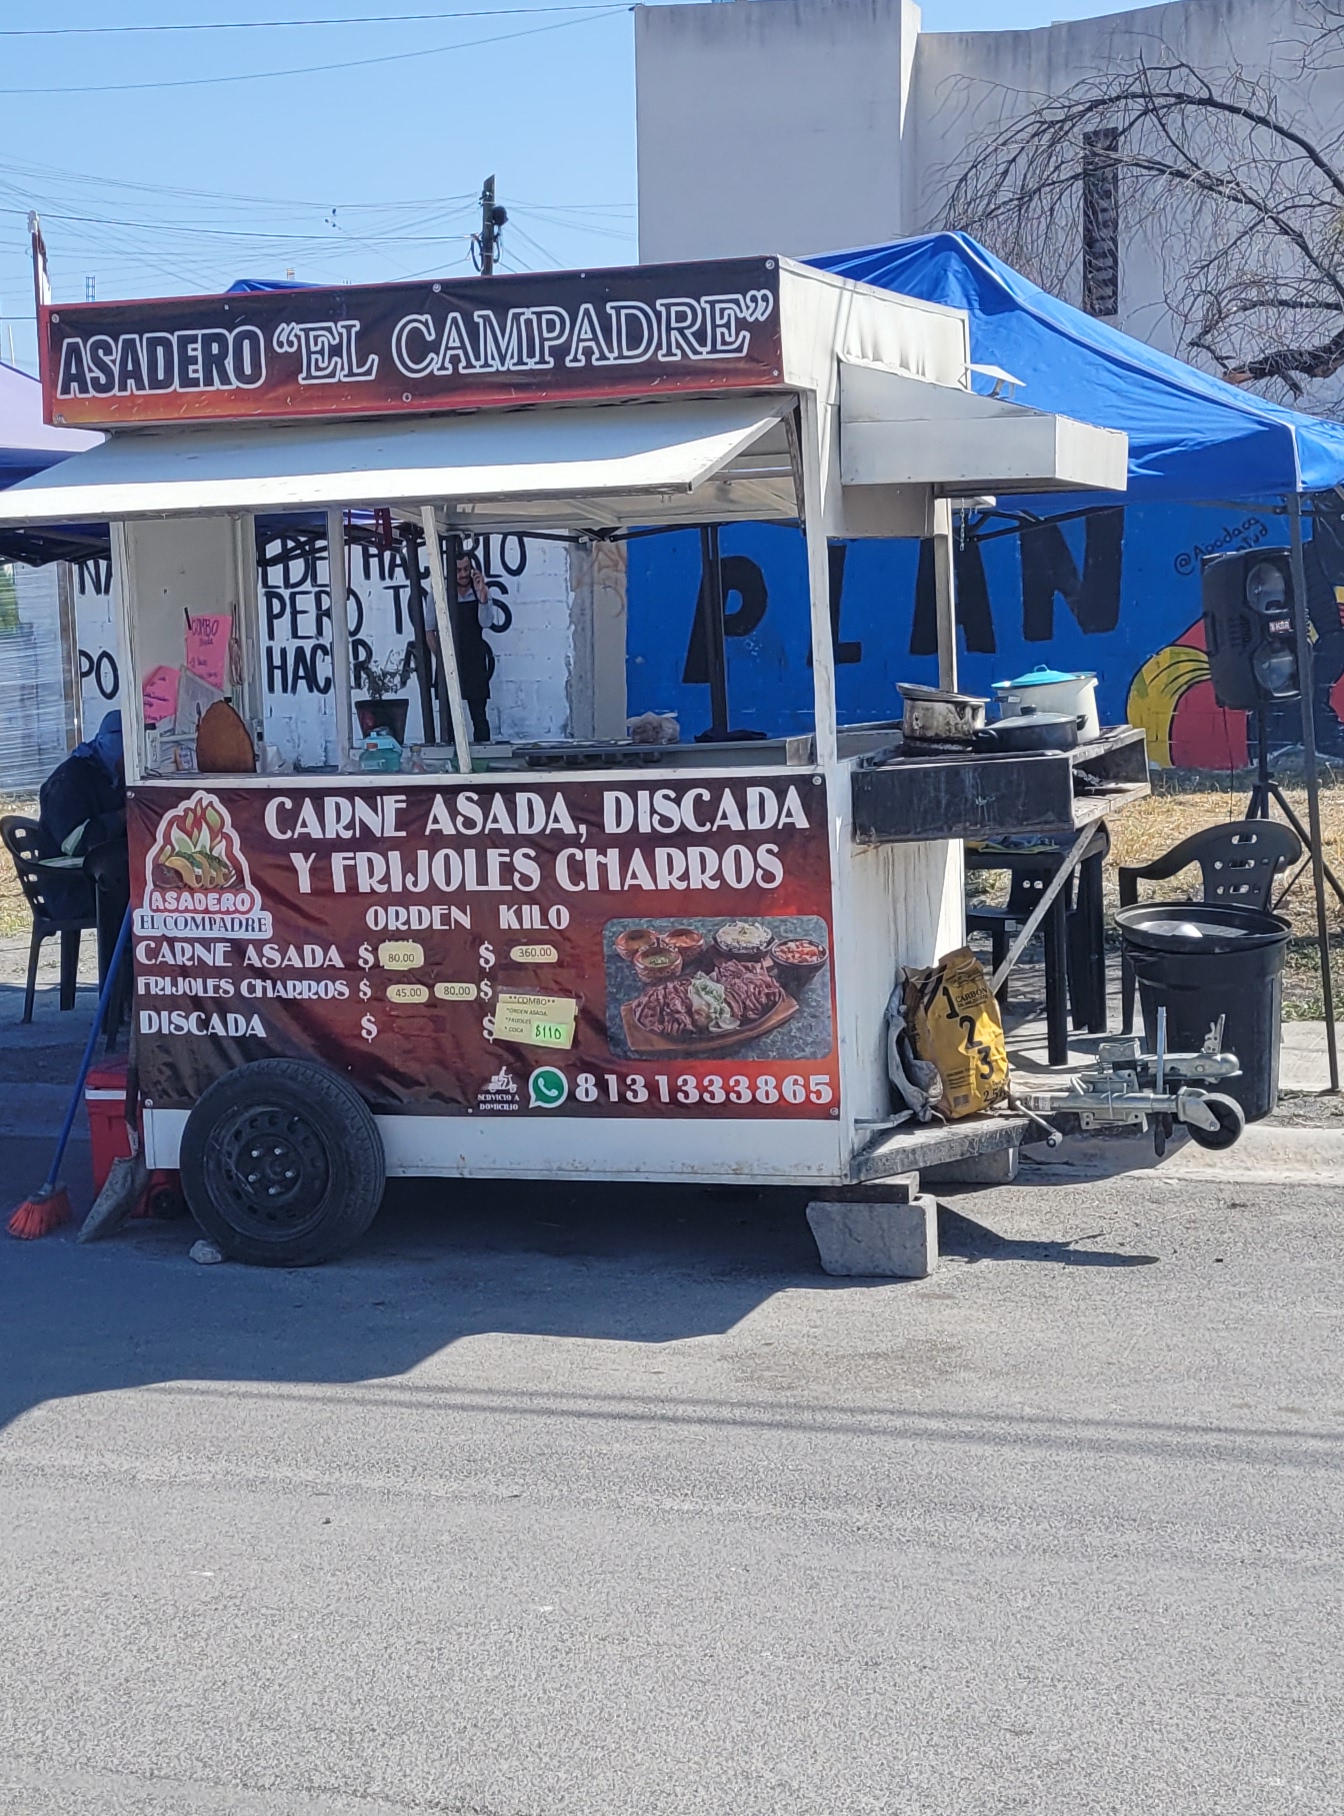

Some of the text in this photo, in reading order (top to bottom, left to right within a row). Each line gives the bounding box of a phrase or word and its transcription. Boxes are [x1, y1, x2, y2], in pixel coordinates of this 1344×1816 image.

[56, 325, 267, 400] ASADERO
[264, 785, 811, 844] CARNE ASADA, DISCADA
[289, 843, 786, 894] Y FRIJOLES CHARROS
[151, 891, 252, 912] ASADERO
[365, 904, 570, 931] ORDEN KILO
[139, 914, 268, 933] EL COMPADRE
[135, 940, 552, 972] CARNE ASADA $ 80.00 $ 360.00
[137, 976, 493, 1002] FRIJOLES CHARROS $ 45.00 80.00 $
[942, 985, 960, 1019] 1
[139, 1010, 268, 1038] DISCADA
[360, 1012, 378, 1043] $
[535, 1023, 562, 1040] $110
[959, 1015, 983, 1050] 2
[977, 1045, 995, 1080] 3
[477, 1093, 520, 1102] SERVICIO A
[574, 1073, 834, 1105] 8131333865
[479, 1102, 519, 1111] DOMICILIO
